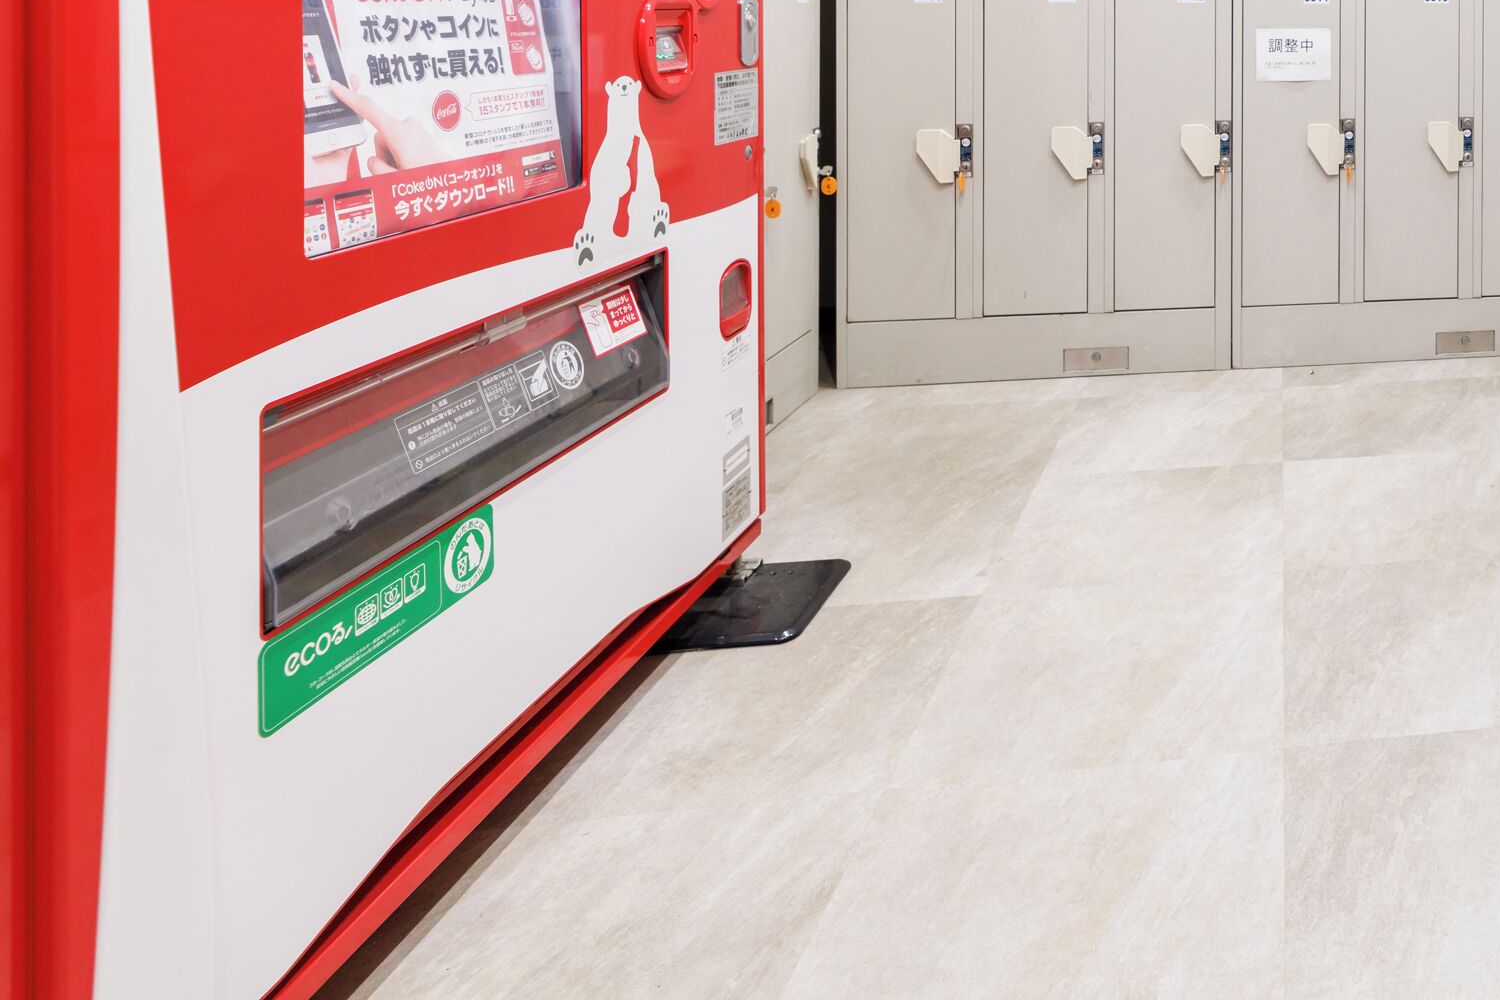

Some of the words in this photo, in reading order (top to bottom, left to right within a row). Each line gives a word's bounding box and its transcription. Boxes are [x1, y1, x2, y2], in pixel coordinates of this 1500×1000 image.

[360, 13, 500, 43] ボタンやコインに
[1268, 38, 1314, 55] 調整中
[366, 46, 506, 86] 触れずに買える!
[394, 176, 516, 222] 今すぐダウンロード!!
[609, 304, 633, 319] まってから
[612, 312, 637, 328] ゆっくりと
[449, 519, 486, 552] のんだあとは
[454, 565, 484, 593] リサイクル
